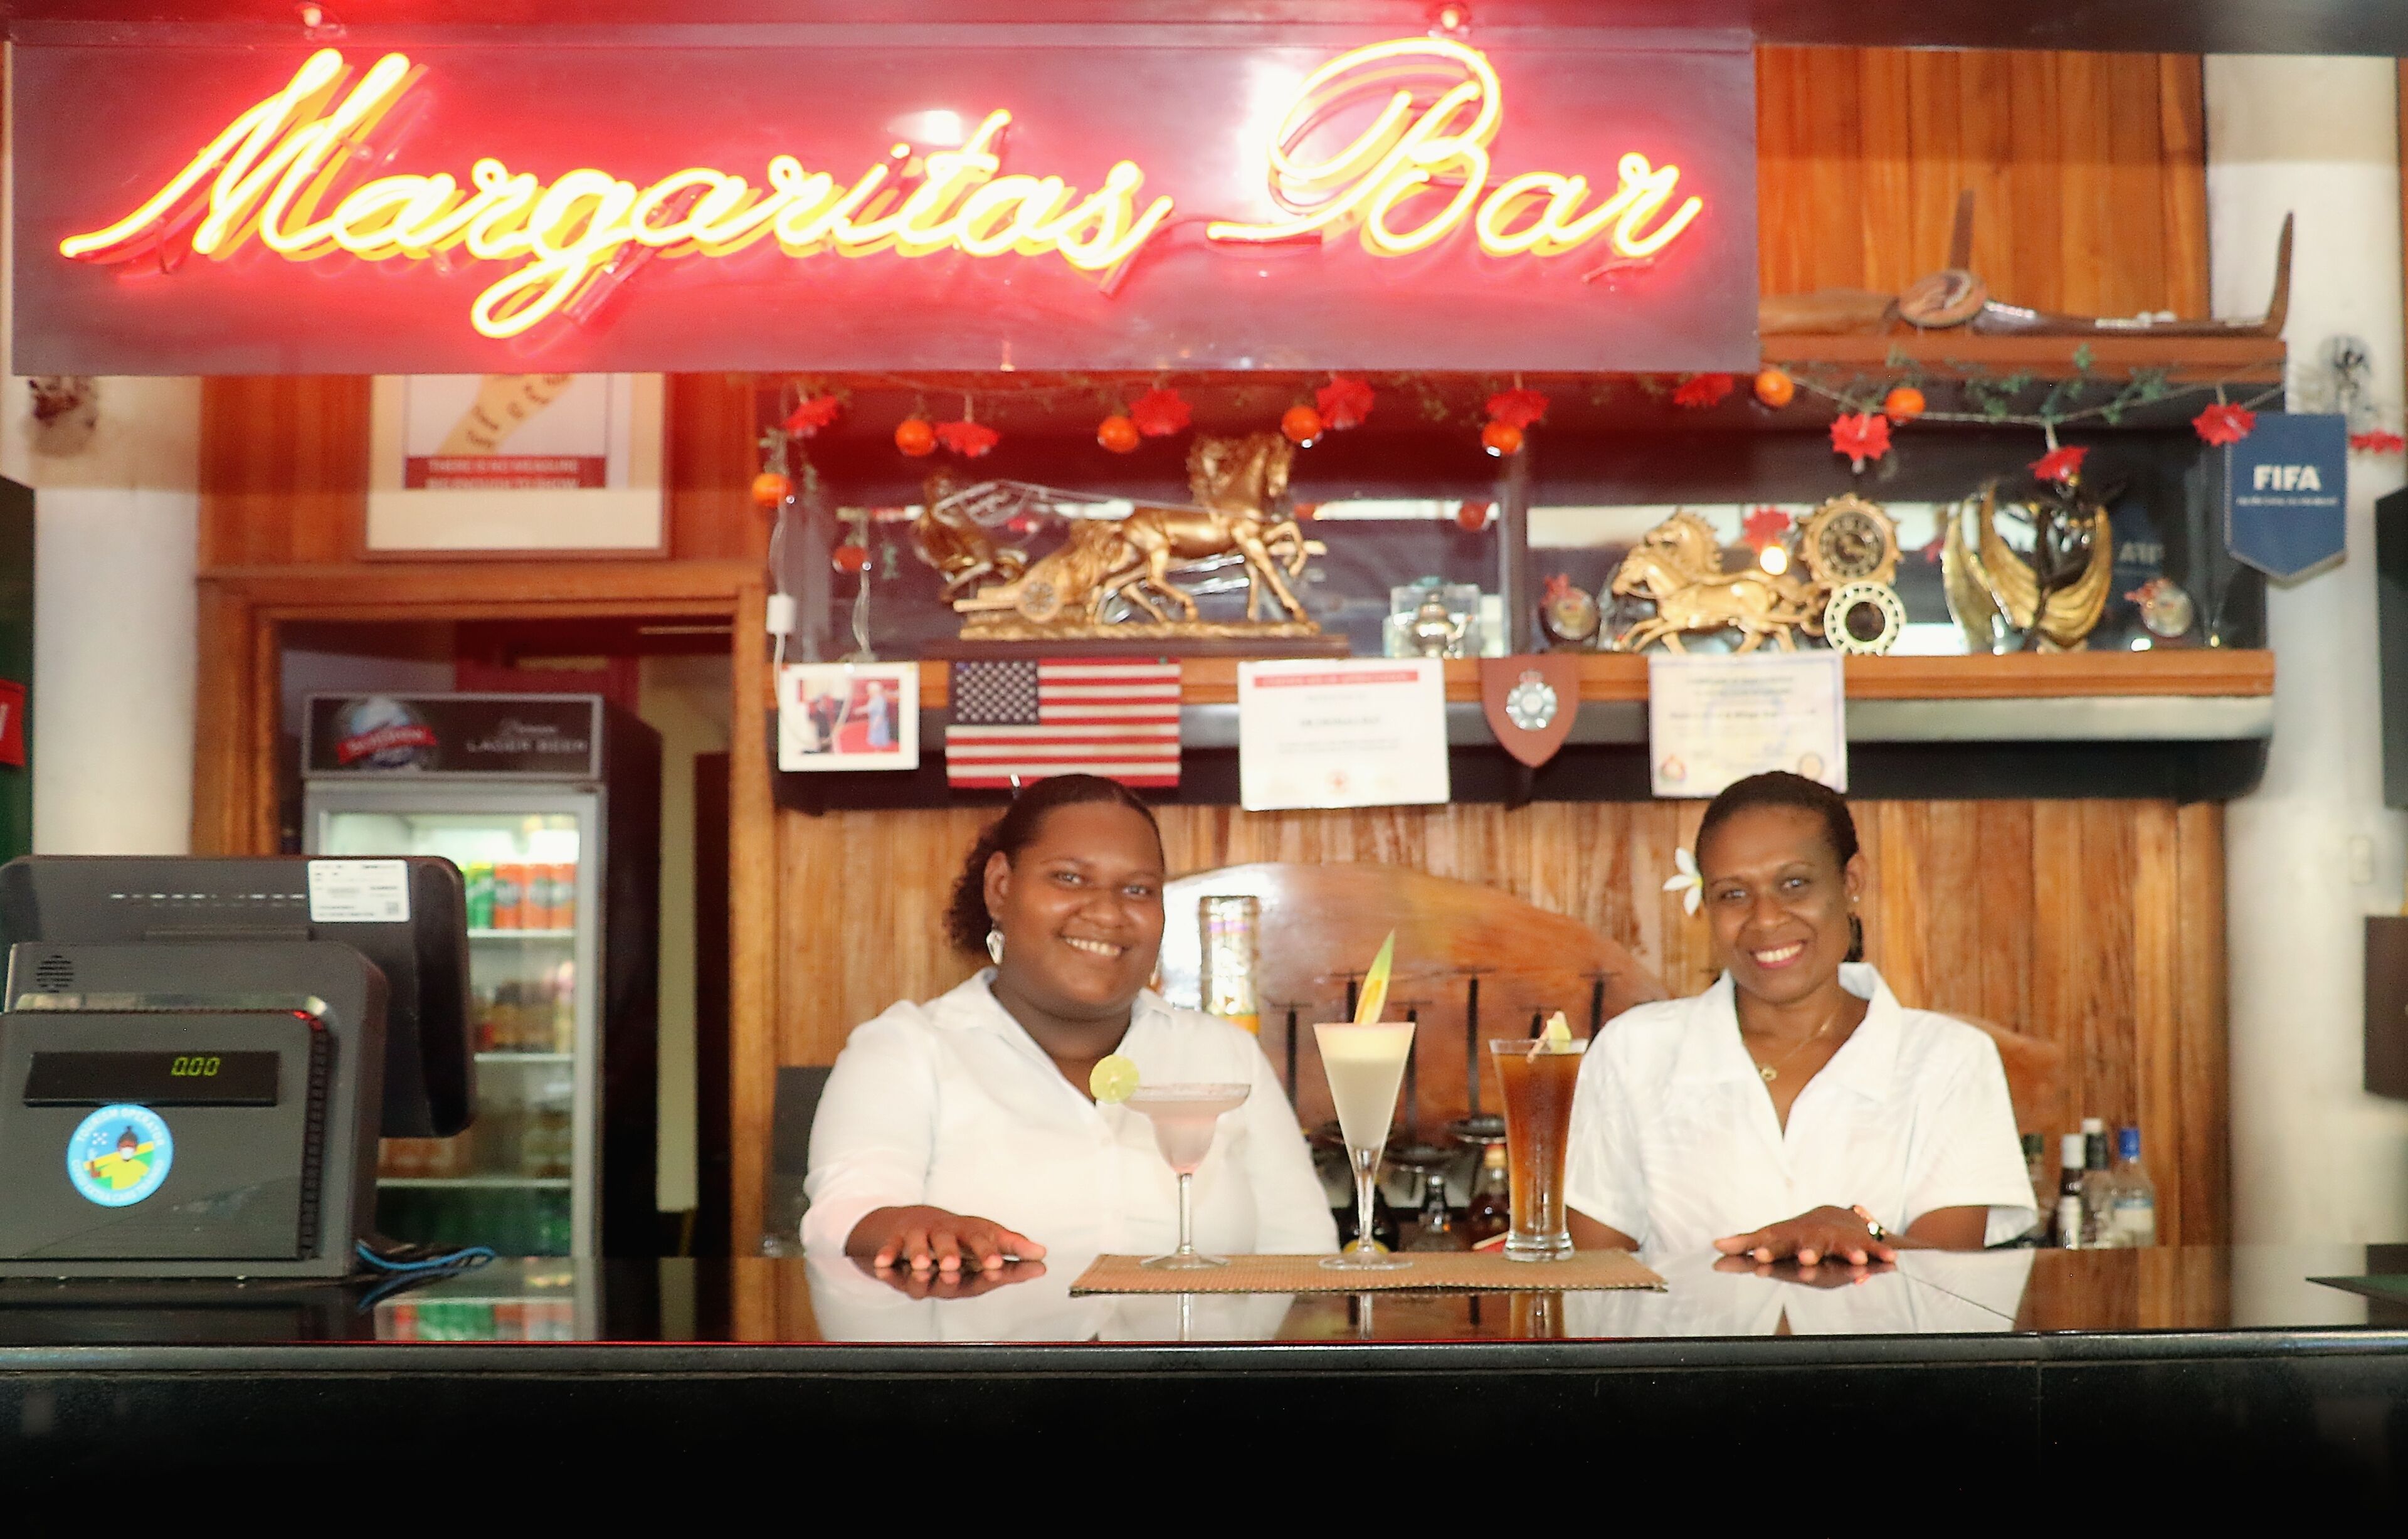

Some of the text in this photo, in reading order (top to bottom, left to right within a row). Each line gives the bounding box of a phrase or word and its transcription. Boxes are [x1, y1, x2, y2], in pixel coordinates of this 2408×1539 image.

[60, 36, 1703, 338] Margaritas Bar
[2252, 465, 2321, 491] FIFA
[171, 1057, 220, 1076] 0.00
[75, 1108, 165, 1146] TOURISM OPERATOR
